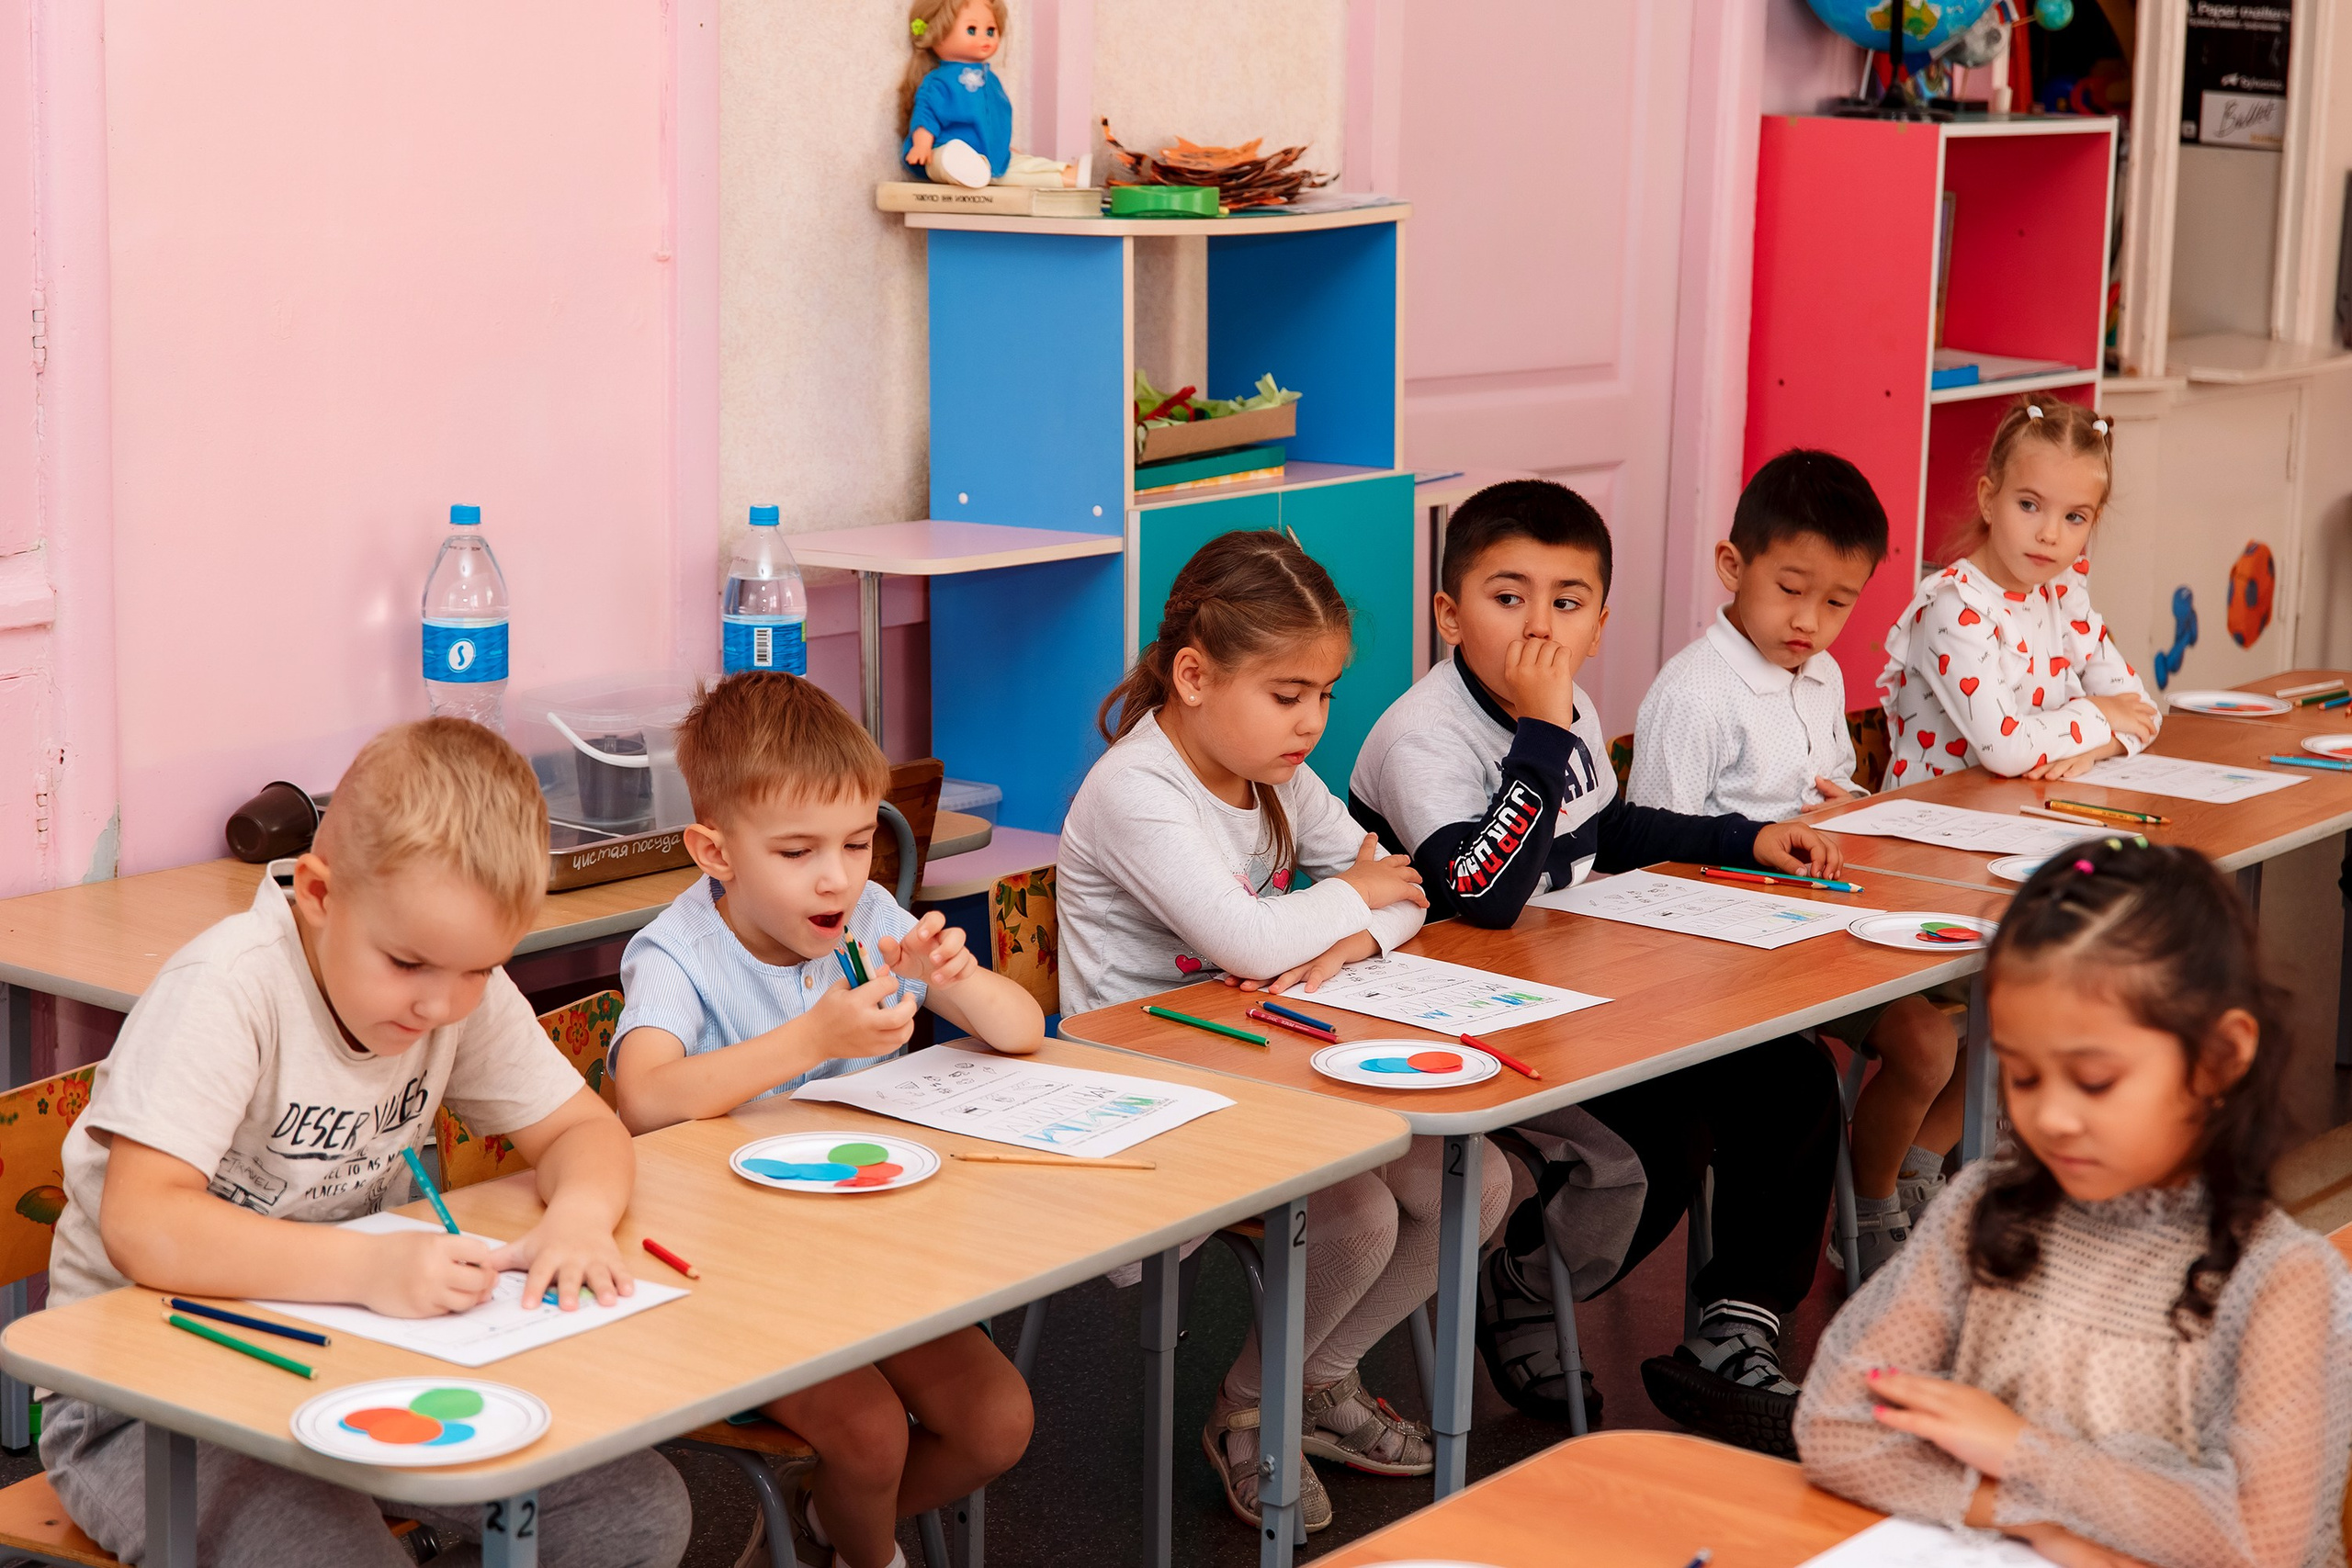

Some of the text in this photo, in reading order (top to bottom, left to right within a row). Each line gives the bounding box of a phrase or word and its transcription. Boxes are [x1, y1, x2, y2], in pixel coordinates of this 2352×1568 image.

[631, 834, 681, 853] посуда
[1457, 787, 1537, 892] JORDAN
[368, 1157, 381, 1171] AS
[1448, 1143, 1464, 1177] 2
[1293, 1210, 1306, 1247] 2
[485, 1500, 505, 1533] 2
[517, 1499, 536, 1539] 2
